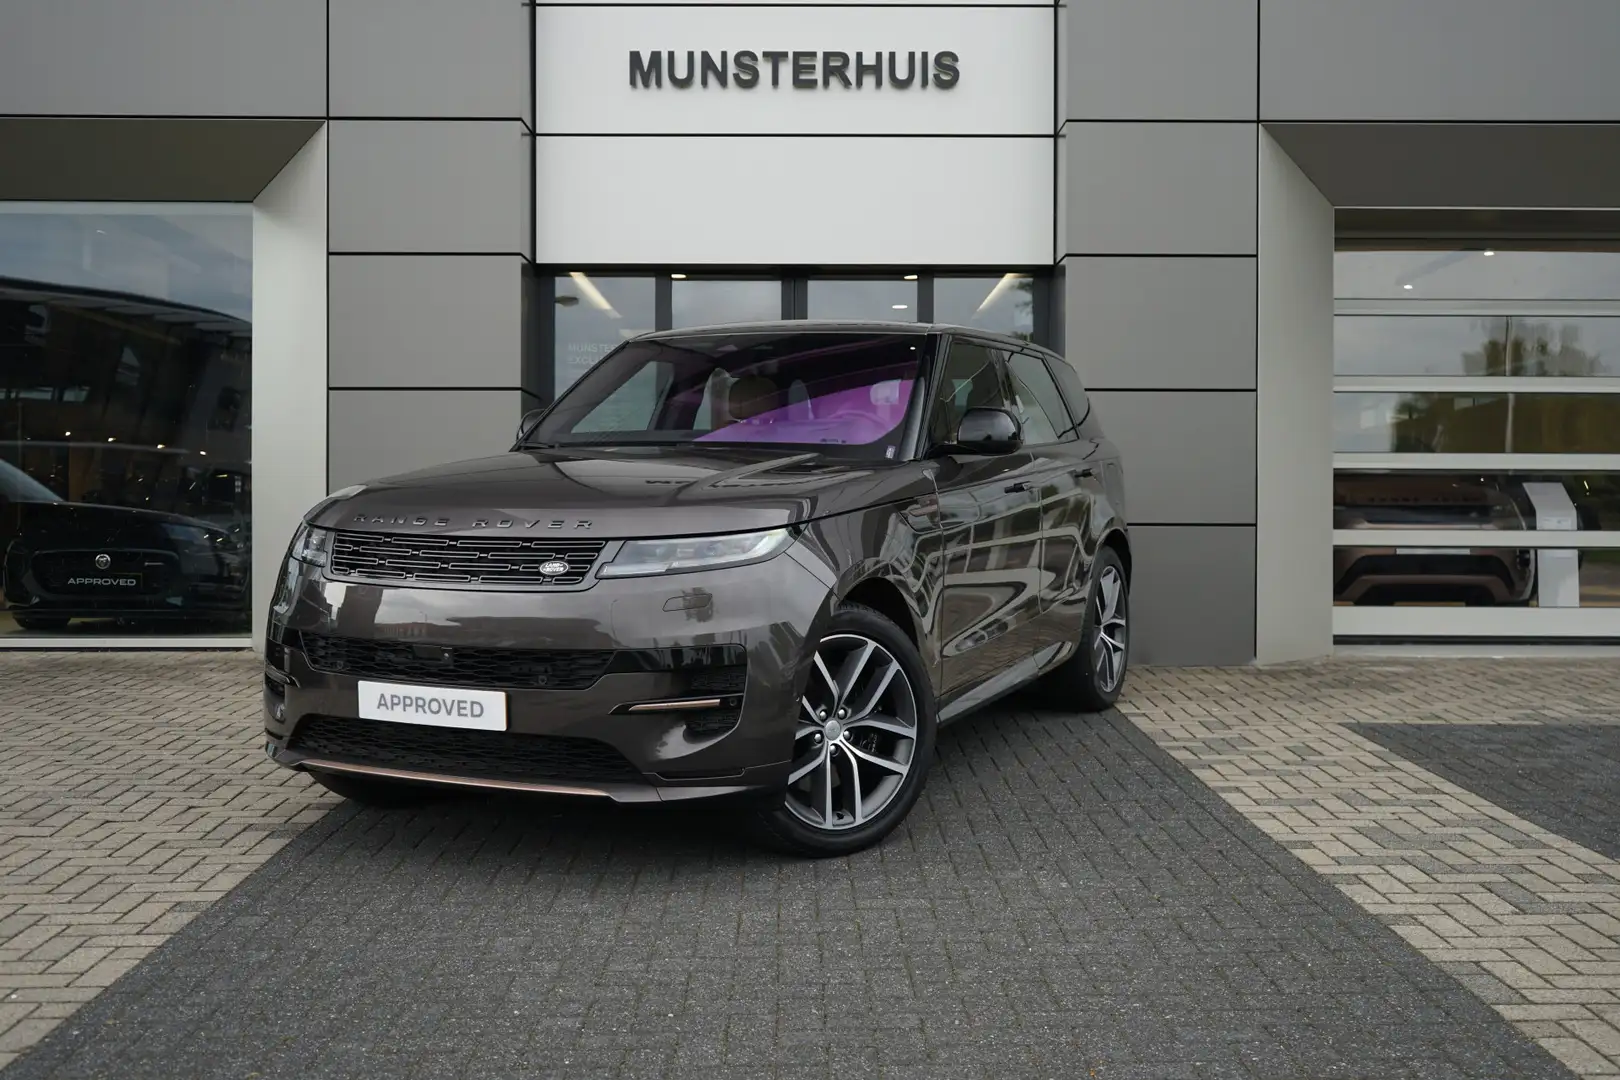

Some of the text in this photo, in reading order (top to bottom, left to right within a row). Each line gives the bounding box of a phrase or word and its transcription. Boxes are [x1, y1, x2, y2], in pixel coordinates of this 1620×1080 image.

[629, 50, 961, 89] MUNSTERHUIS
[353, 514, 593, 530] RANGE ROVER
[67, 577, 137, 586] APPROVED
[376, 693, 485, 718] APPROVED
